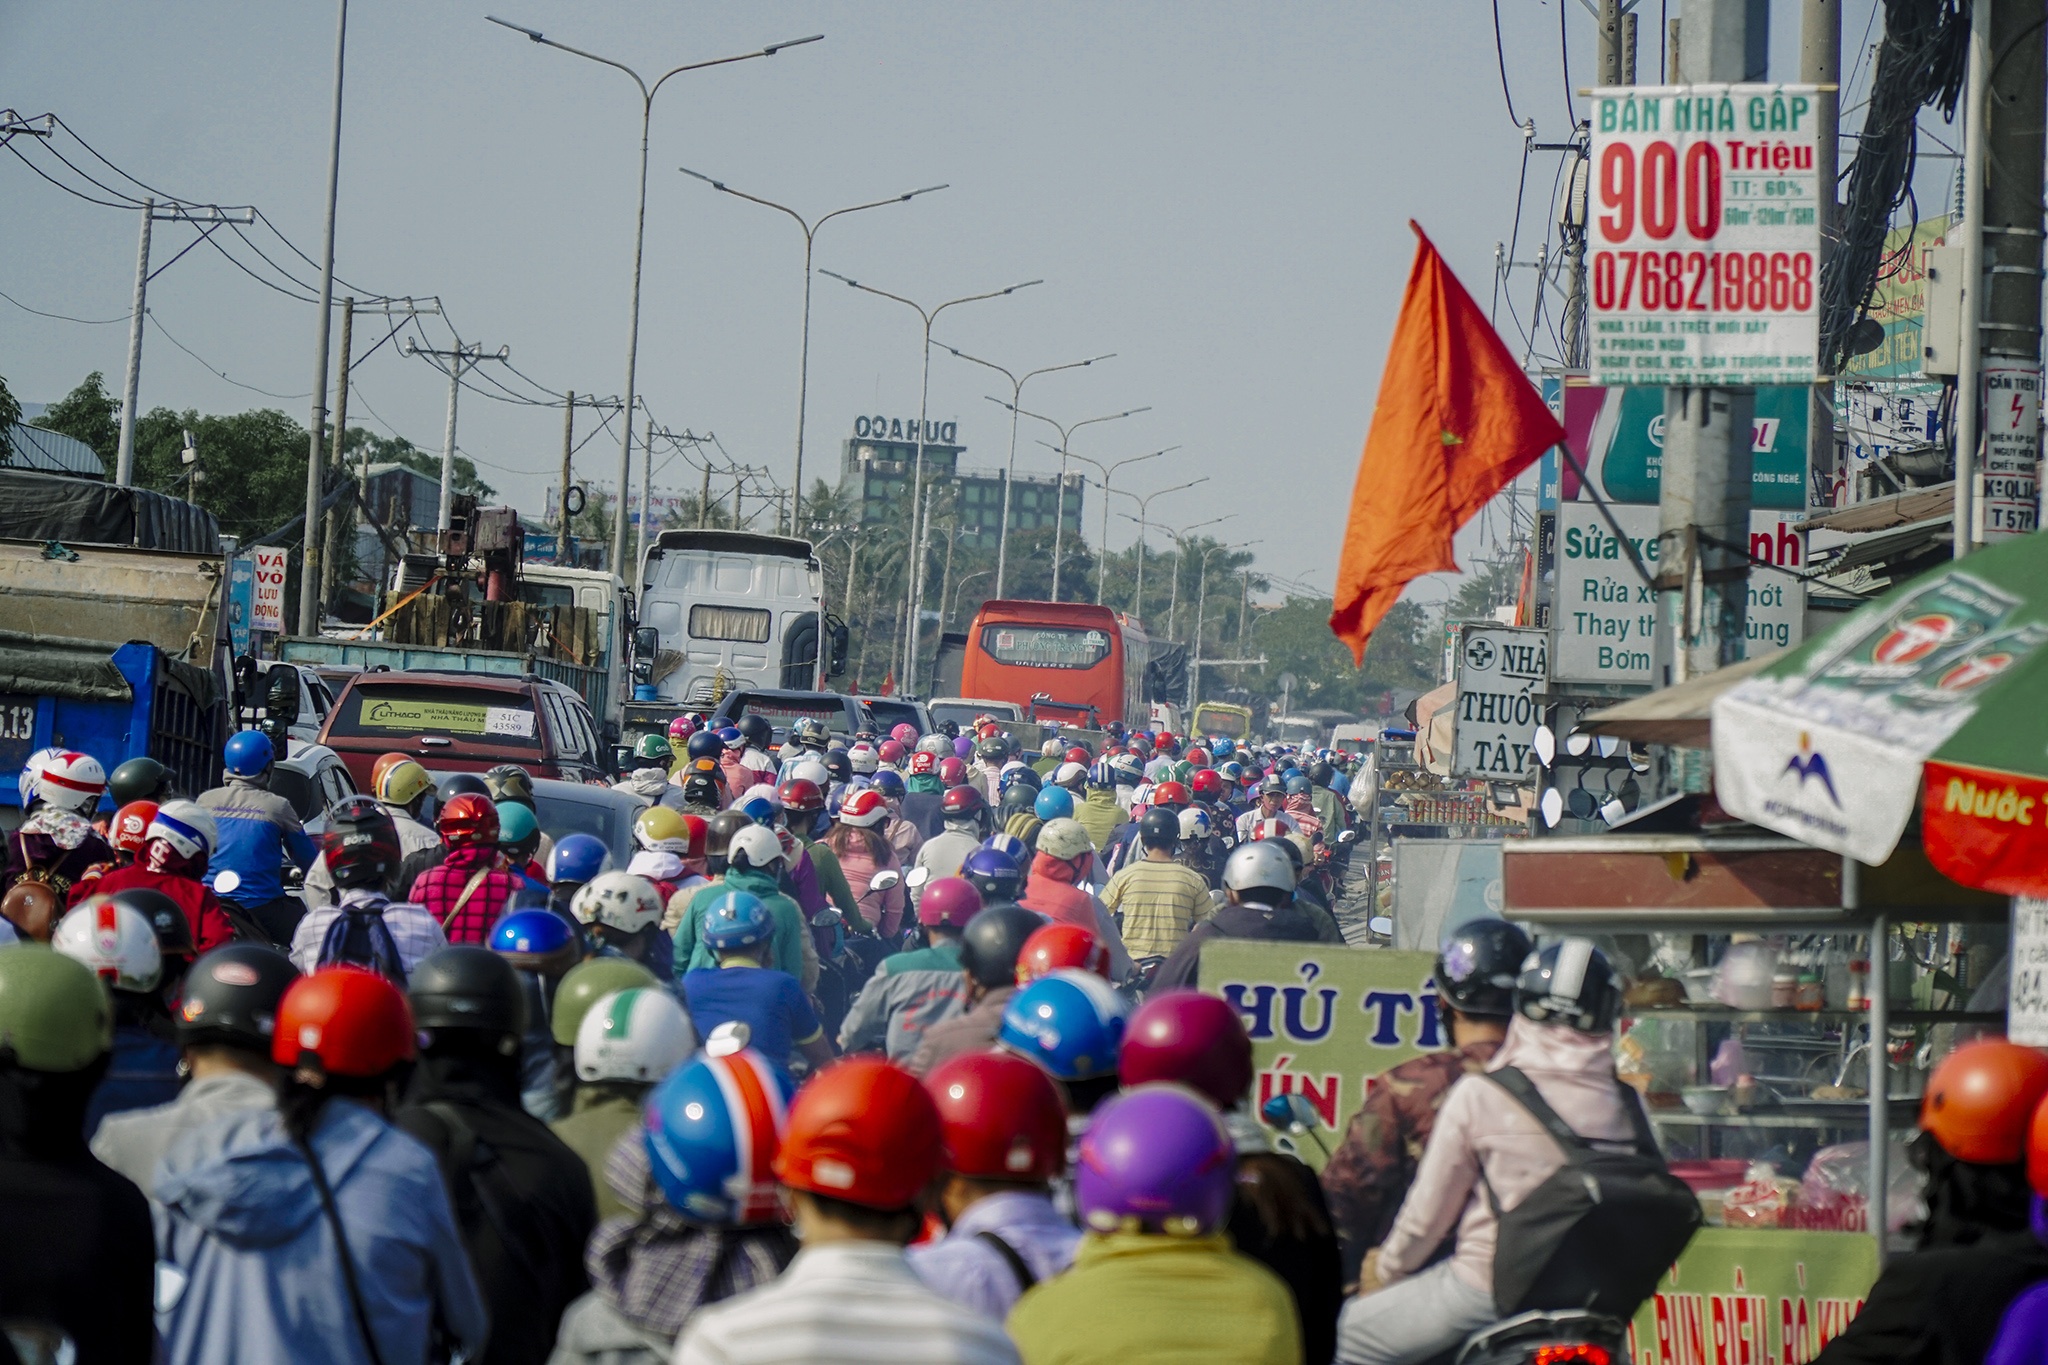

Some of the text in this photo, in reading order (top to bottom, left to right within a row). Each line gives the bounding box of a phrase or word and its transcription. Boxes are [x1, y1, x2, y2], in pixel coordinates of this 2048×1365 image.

[1600, 83, 1809, 132] BÁN NHÀ GẤP
[1726, 141, 1812, 176] Triệu
[1599, 141, 1722, 243] 900
[1732, 181, 1803, 196] TT: 60%
[1594, 251, 1813, 312] 0768219868
[1647, 456, 1663, 466] KHÔ
[1753, 472, 1775, 483] CÔNG
[258, 552, 284, 567] VÁ
[1565, 524, 1619, 560] Sửa
[1628, 537, 1661, 562] xe
[1751, 522, 1800, 566] nh
[256, 569, 284, 585] VỎ
[1583, 576, 1628, 603] Rửa
[1747, 583, 1782, 608] hớt
[254, 602, 279, 620] ĐỘNG
[1573, 612, 1631, 641] Thay
[1638, 614, 1657, 637] th
[1745, 615, 1789, 648] ùng
[1501, 639, 1546, 675] NHÀ
[1599, 647, 1650, 670] Bơm
[492, 723, 522, 732] 43589
[500, 713, 521, 722] 51C
[1474, 733, 1531, 774] TÂY
[1945, 776, 2034, 825] Nước
[1223, 963, 1338, 1041] HỦ
[1258, 1056, 1338, 1129] ÚN
